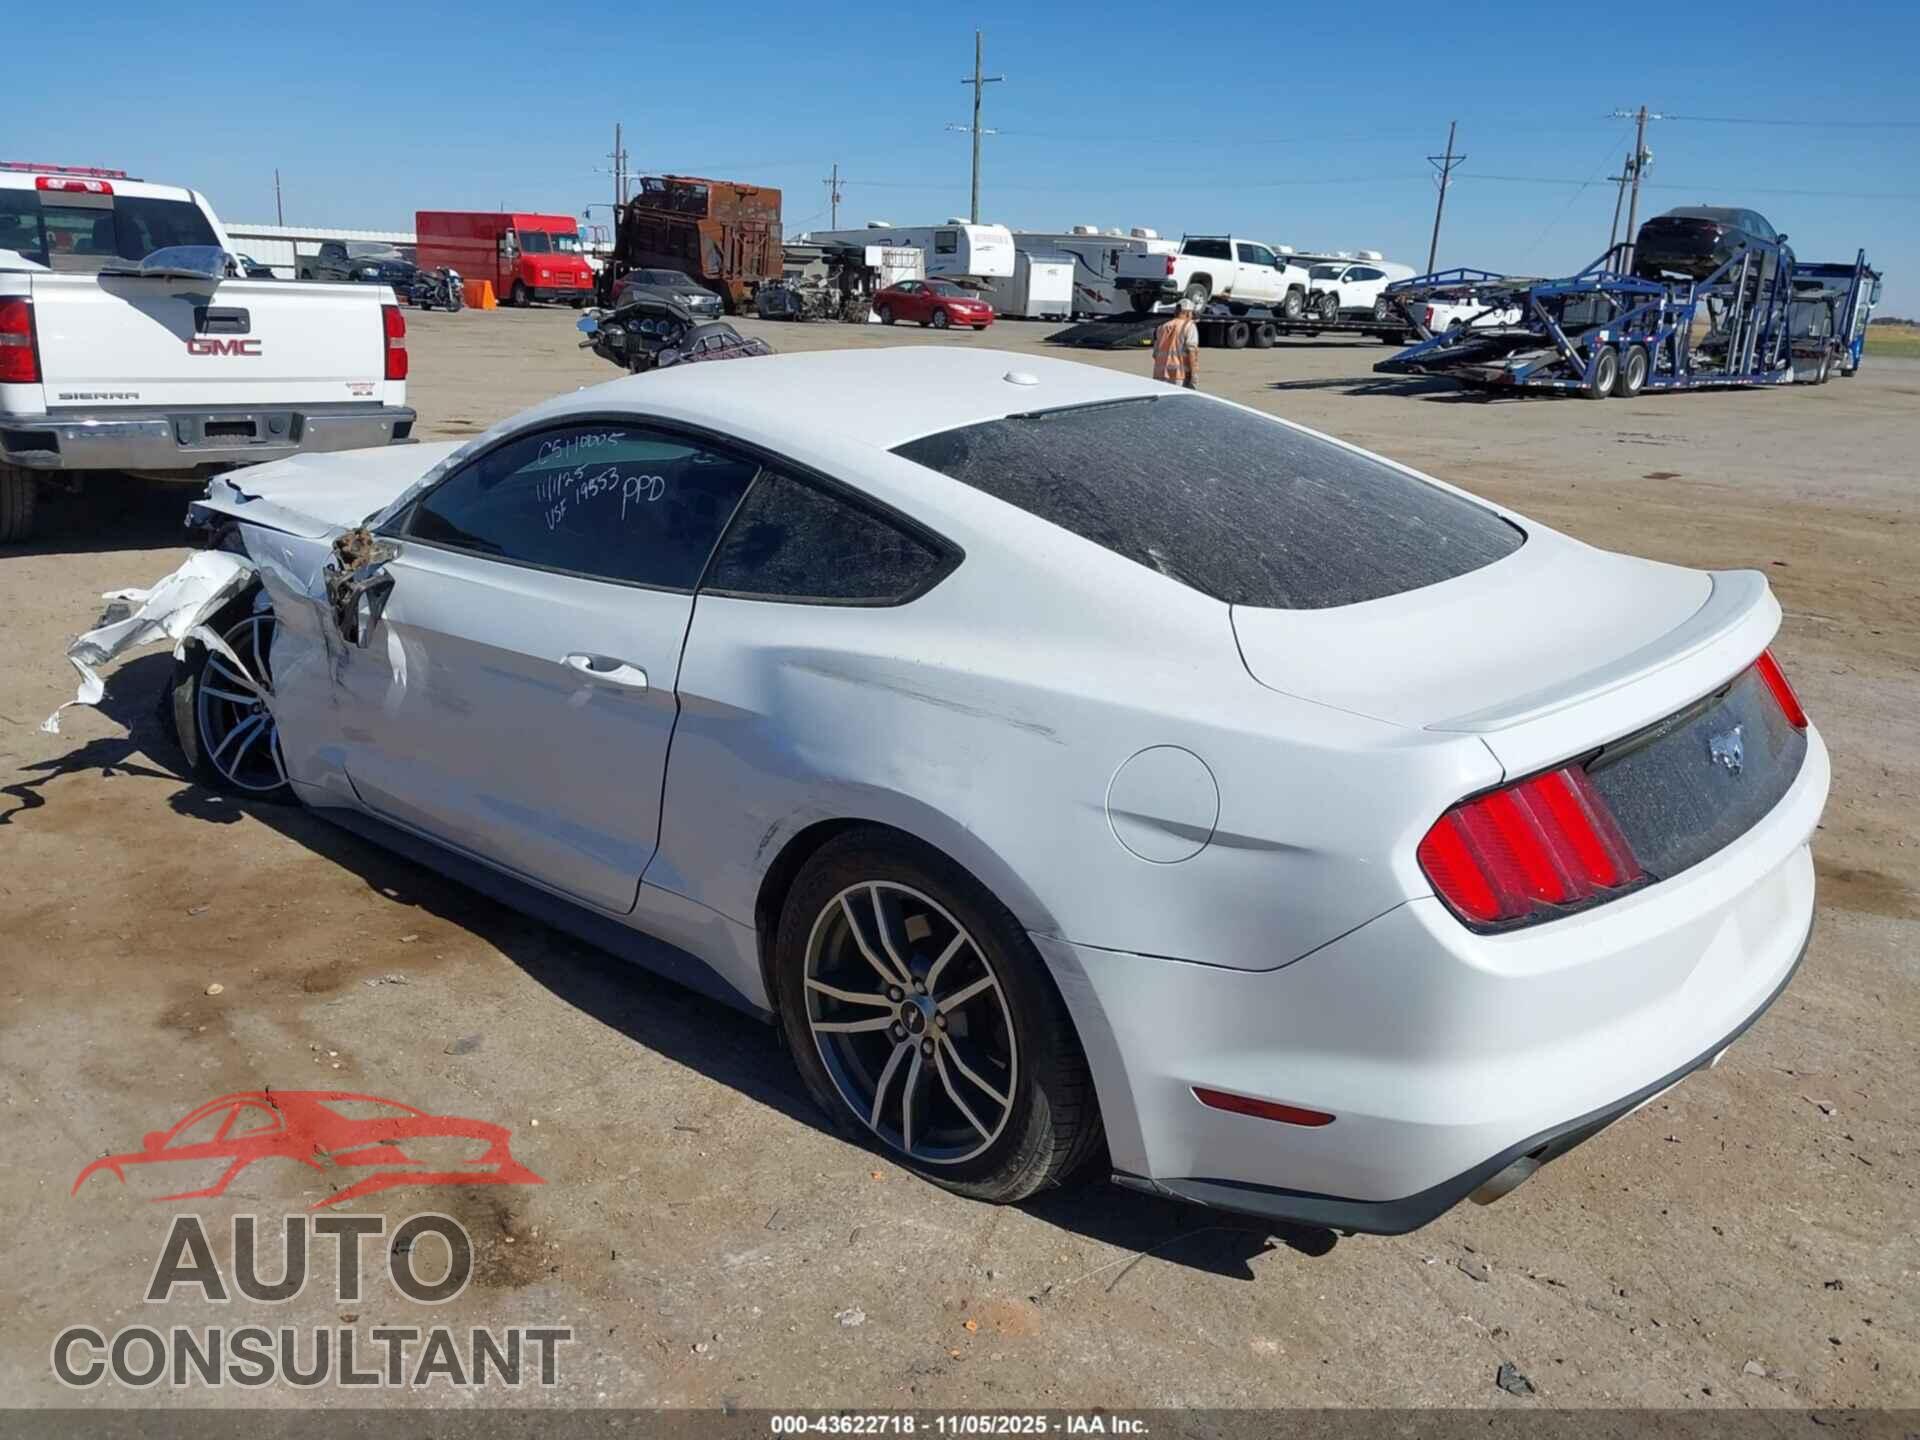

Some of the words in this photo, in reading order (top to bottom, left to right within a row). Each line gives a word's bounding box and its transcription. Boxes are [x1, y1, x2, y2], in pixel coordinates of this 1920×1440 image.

[187, 338, 262, 356] GMC
[58, 392, 141, 400] SIERRA
[622, 475, 665, 521] PPD
